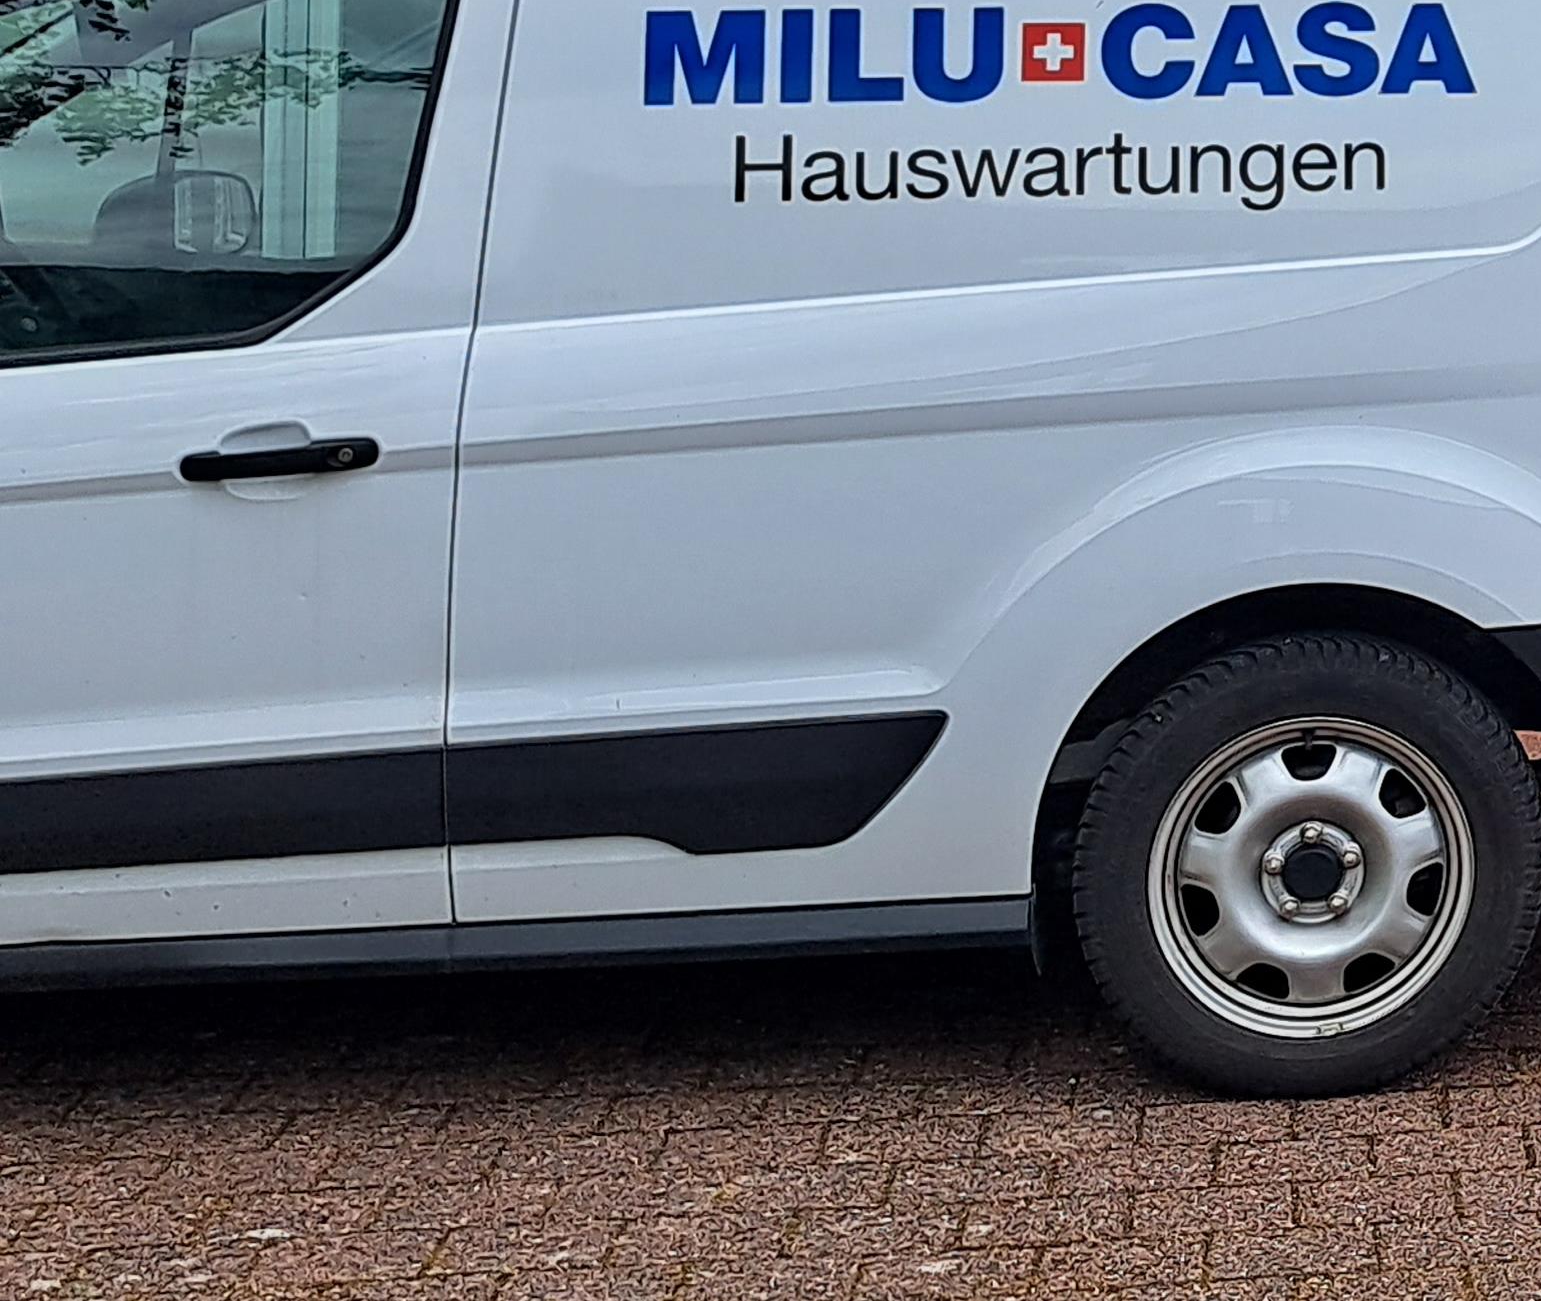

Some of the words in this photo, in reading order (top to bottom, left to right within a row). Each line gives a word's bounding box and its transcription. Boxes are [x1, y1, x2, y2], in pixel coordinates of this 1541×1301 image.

[643, 7, 1005, 106] MILU
[1100, 2, 1478, 100] CASA
[733, 133, 1386, 211] Hauswartungen
